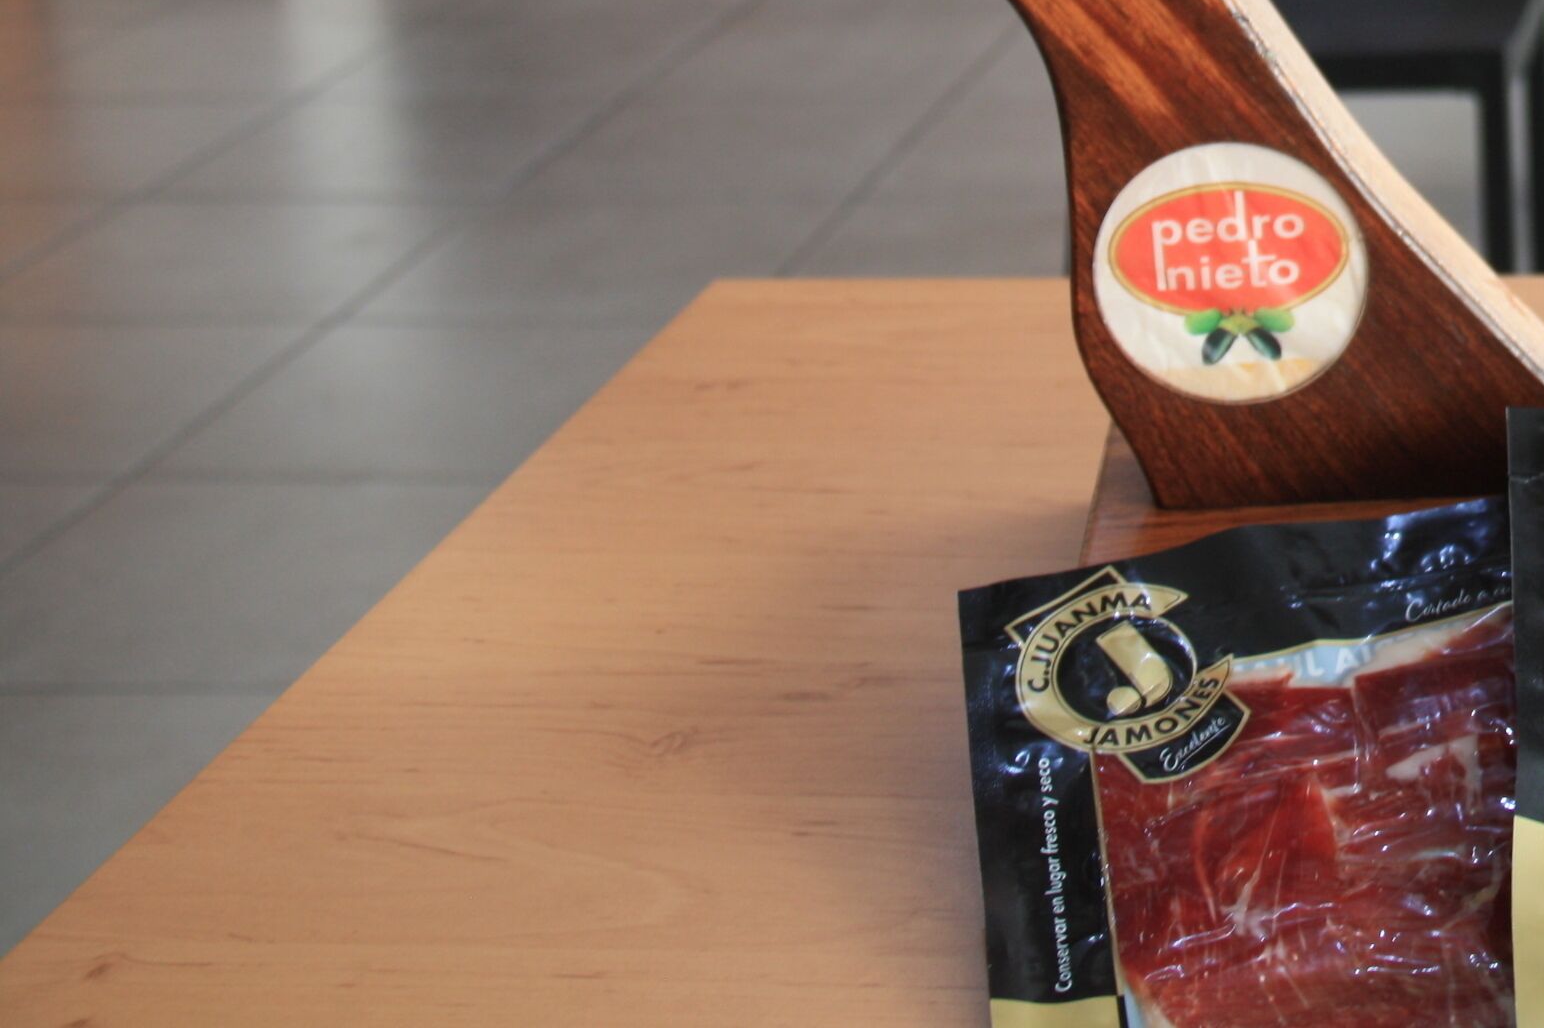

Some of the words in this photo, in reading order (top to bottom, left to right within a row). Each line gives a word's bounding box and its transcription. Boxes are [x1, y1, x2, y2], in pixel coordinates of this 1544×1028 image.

[1151, 190, 1305, 291] pedro
[1166, 239, 1300, 291] nieto
[1083, 676, 1220, 746] JAMONES
[1038, 757, 1053, 793] seco
[1042, 796, 1059, 808] y
[1040, 809, 1059, 854] fresco
[1044, 856, 1066, 896] lugar
[1052, 896, 1065, 914] en
[1054, 917, 1073, 993] Conservar
